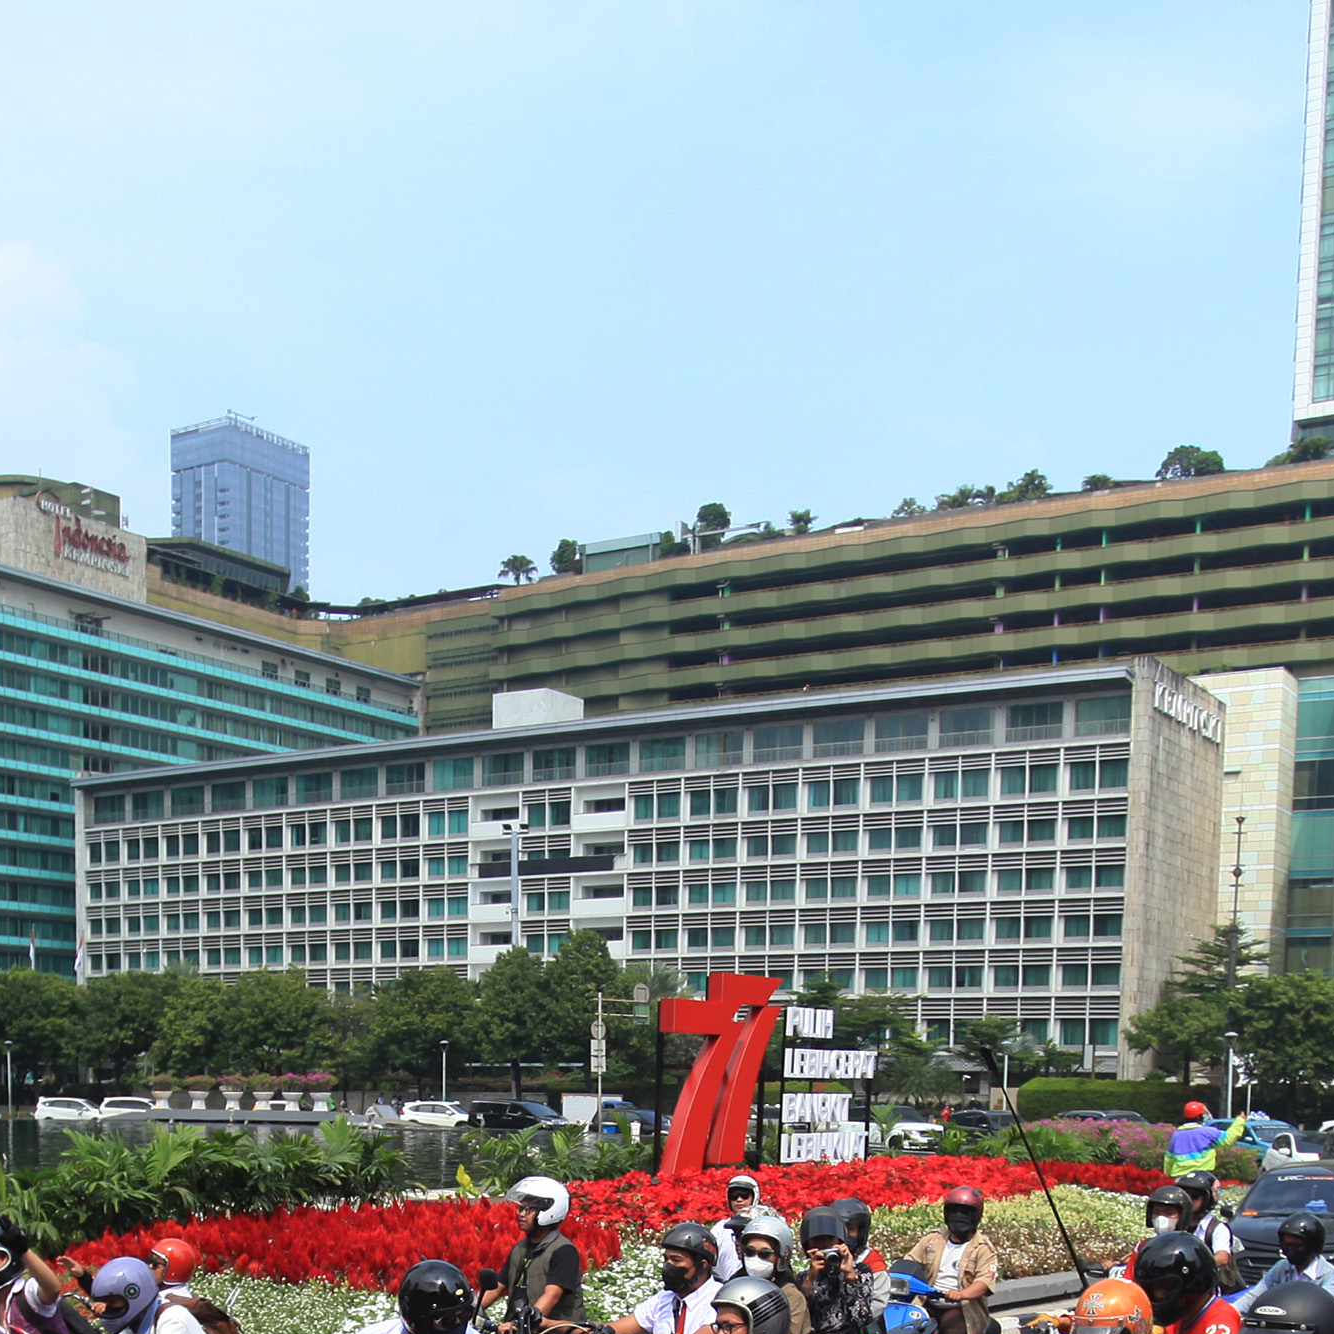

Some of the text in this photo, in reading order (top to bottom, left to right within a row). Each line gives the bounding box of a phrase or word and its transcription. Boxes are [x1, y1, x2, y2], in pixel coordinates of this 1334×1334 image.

[41, 500, 71, 517] HOTEL
[54, 514, 131, 562] Indonesia
[785, 1006, 835, 1039] PULIH
[784, 1048, 878, 1079] LEBIH CEPAT
[781, 1093, 853, 1123] BANGKIT
[780, 1131, 869, 1163] LEBIH KUAT
